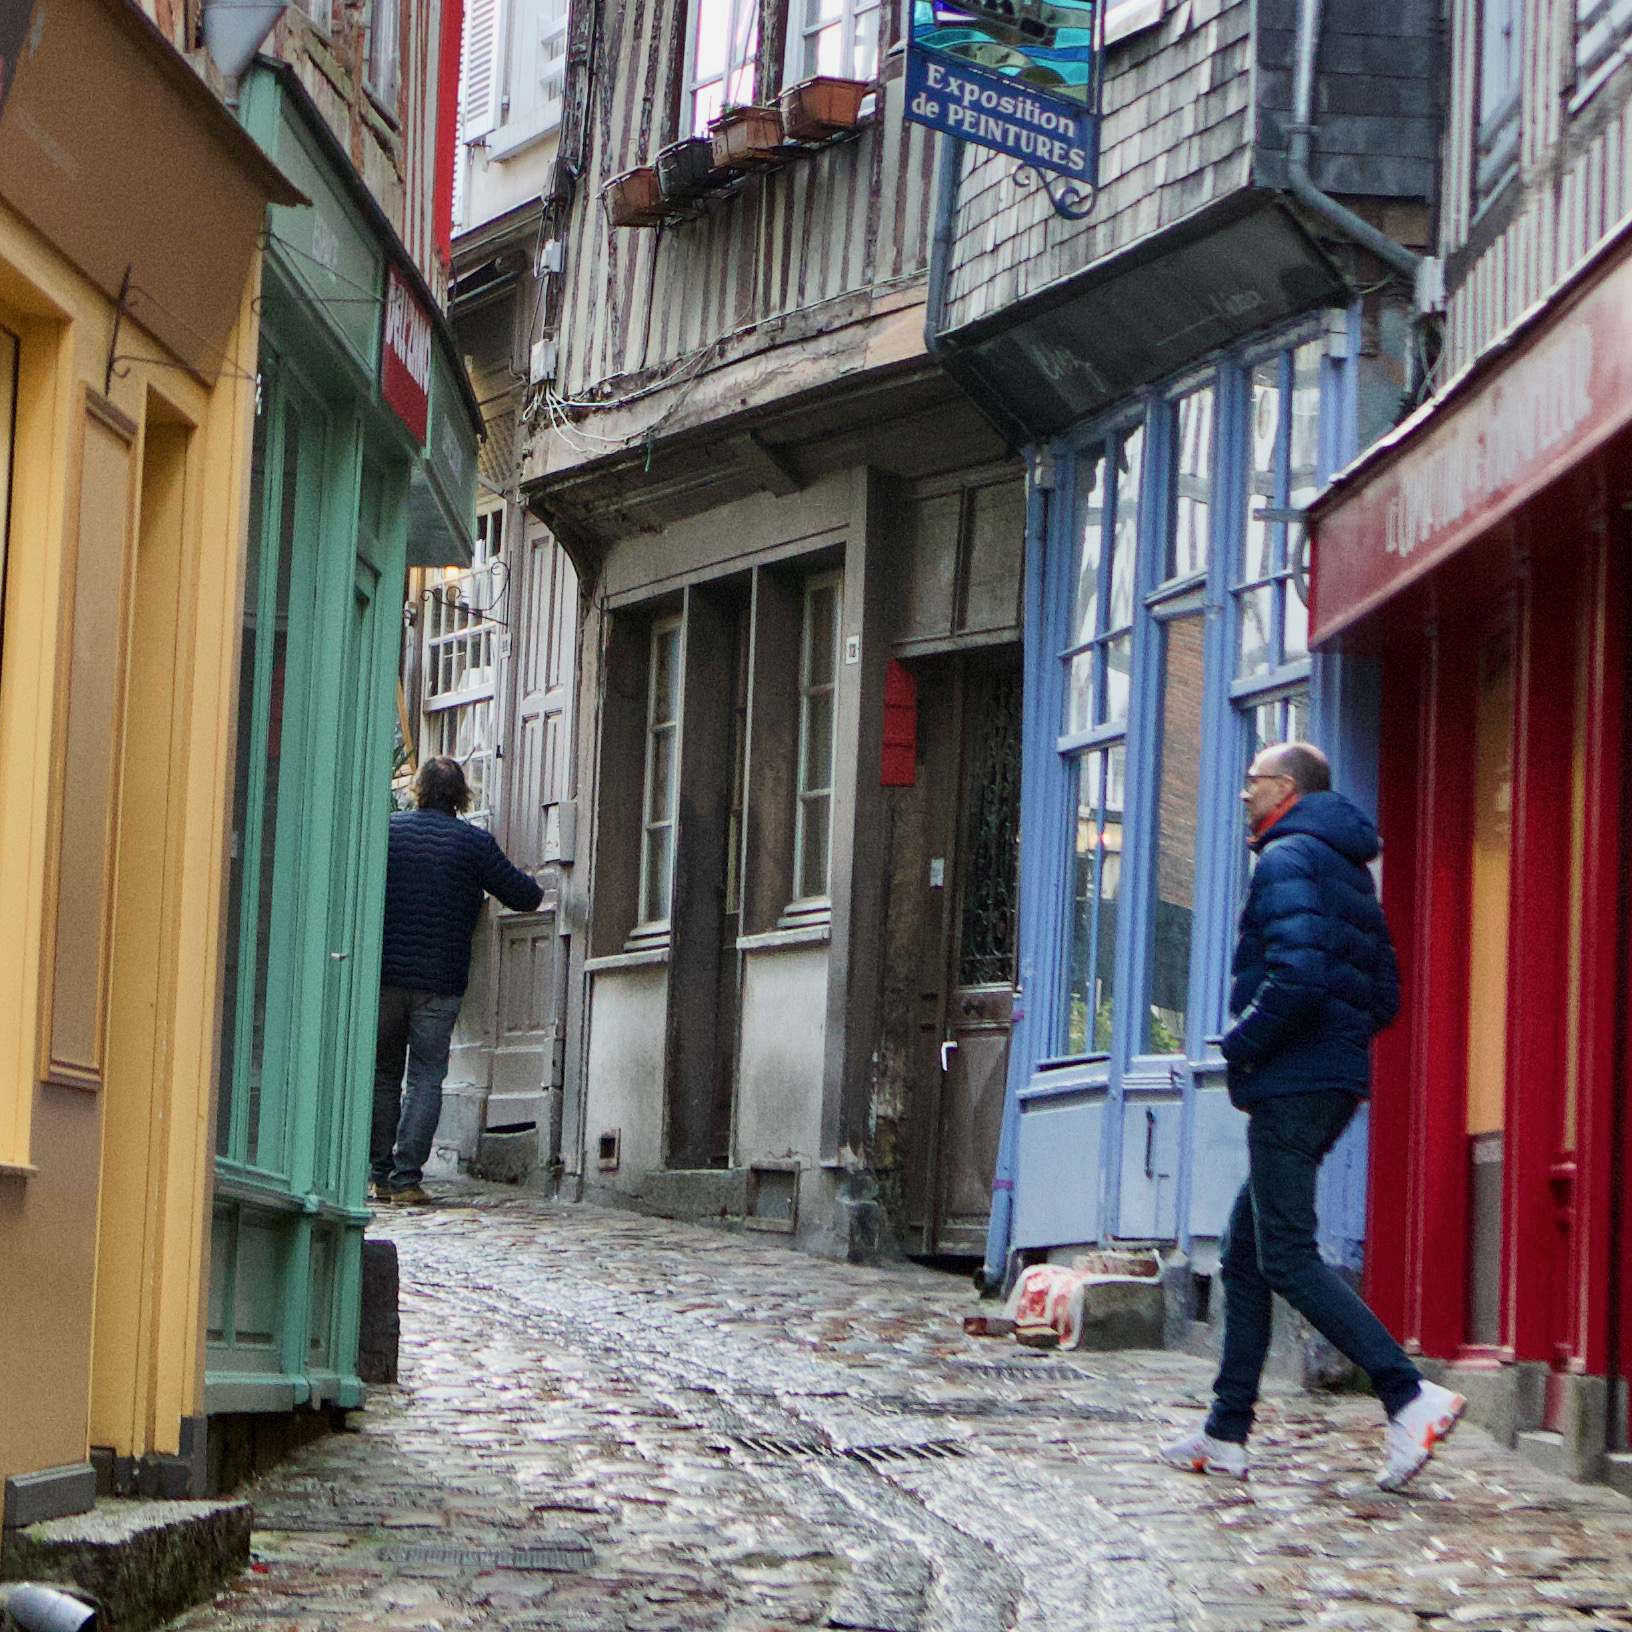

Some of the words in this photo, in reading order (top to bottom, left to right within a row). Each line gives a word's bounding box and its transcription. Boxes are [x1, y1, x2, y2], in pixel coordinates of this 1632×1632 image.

[911, 91, 940, 119] de
[946, 102, 1086, 171] PEINTURES
[926, 62, 1076, 138] Exposition
